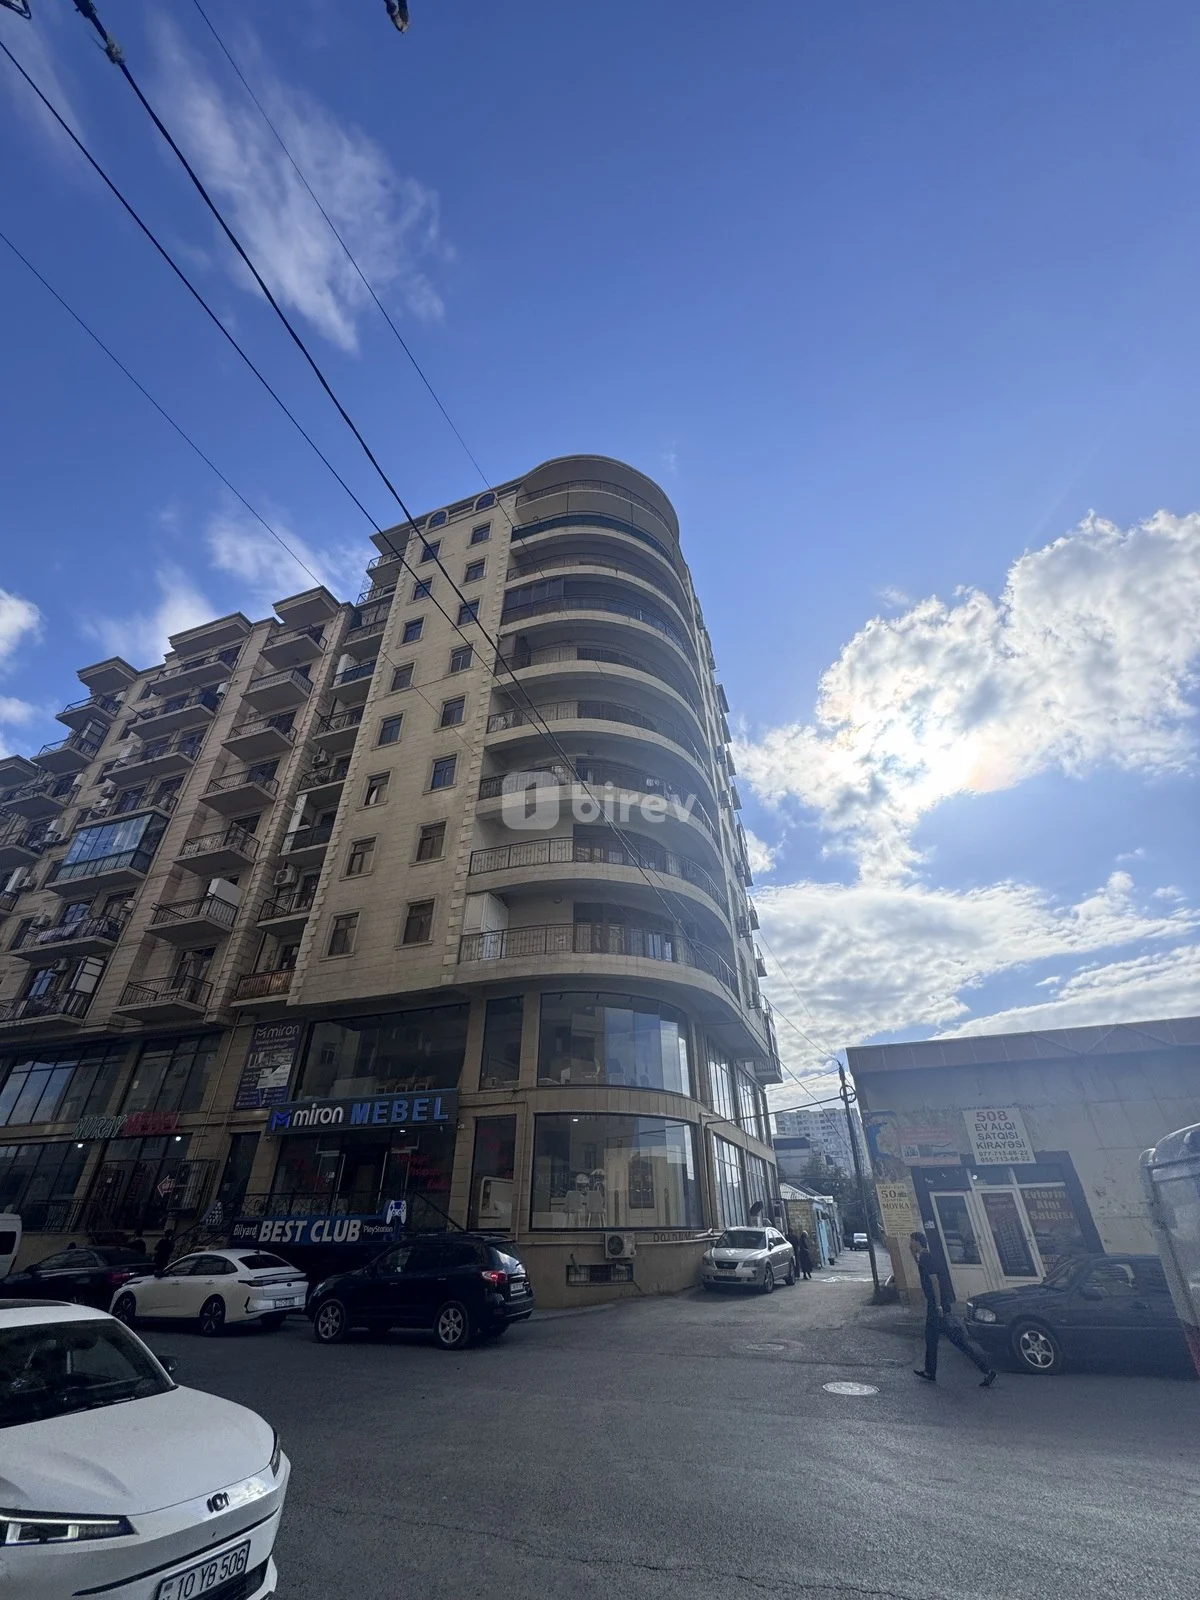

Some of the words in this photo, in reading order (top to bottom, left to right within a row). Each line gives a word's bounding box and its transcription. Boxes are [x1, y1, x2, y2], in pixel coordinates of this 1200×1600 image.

[267, 1024, 299, 1038] miron
[292, 1103, 344, 1127] miron
[350, 1096, 449, 1125] MEBEL
[976, 1110, 1008, 1122] 508
[974, 1123, 988, 1132] EV
[991, 1122, 1016, 1131] ALQI
[977, 1131, 1019, 1140] SATQISI
[881, 1190, 897, 1199] 50
[258, 1220, 308, 1243] BEST
[310, 1219, 362, 1243] CLUB
[363, 1225, 394, 1236] PlayStation
[199, 1562, 218, 1591] YB
[219, 1548, 246, 1580] 506
